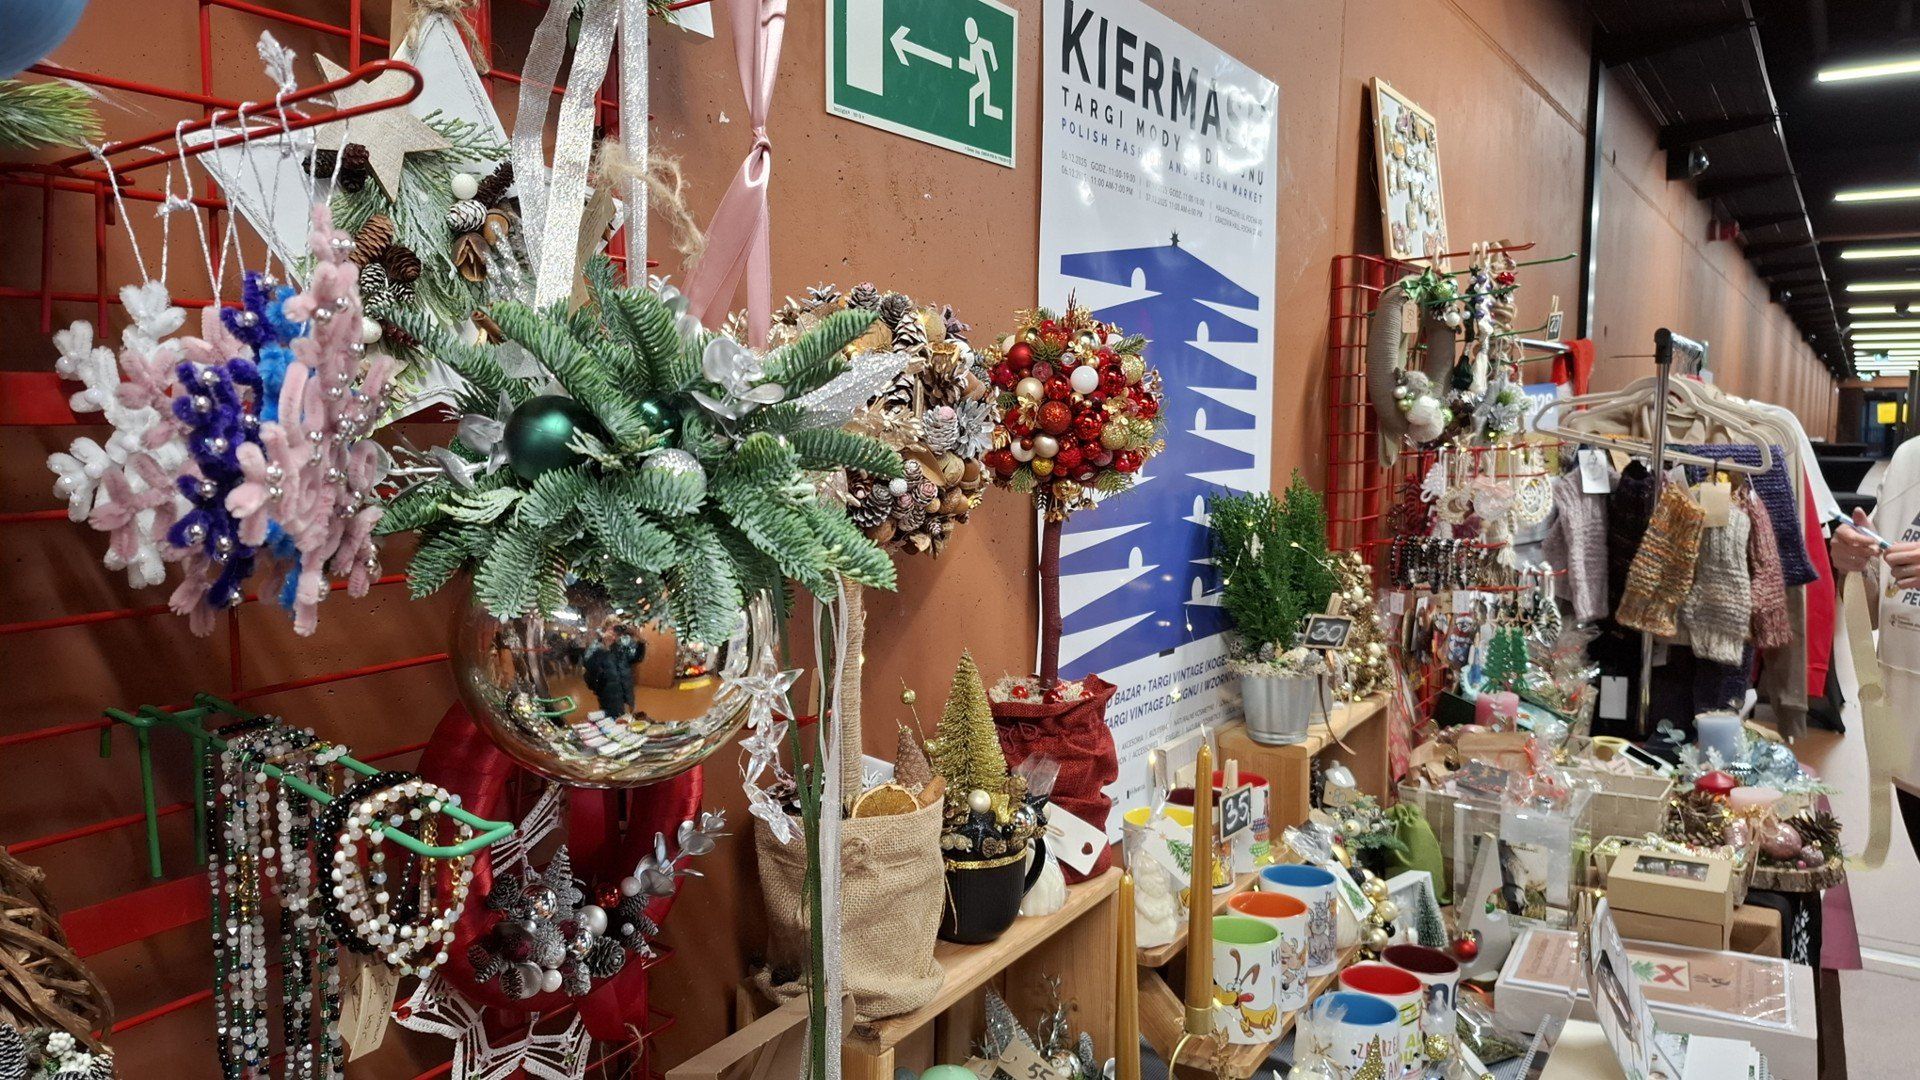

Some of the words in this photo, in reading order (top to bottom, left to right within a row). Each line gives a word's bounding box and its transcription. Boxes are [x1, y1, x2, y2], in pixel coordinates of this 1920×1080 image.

[1062, 86, 1123, 129] TARGI
[1136, 117, 1180, 152] MODY
[1062, 117, 1108, 147] POLISH
[1231, 183, 1263, 205] MARKET
[1115, 684, 1142, 706] BAZAR
[1148, 673, 1172, 692] TARGI
[1173, 661, 1204, 683] VINTAGE
[1105, 711, 1129, 730] TARGI
[1130, 696, 1164, 720] VINTAGE
